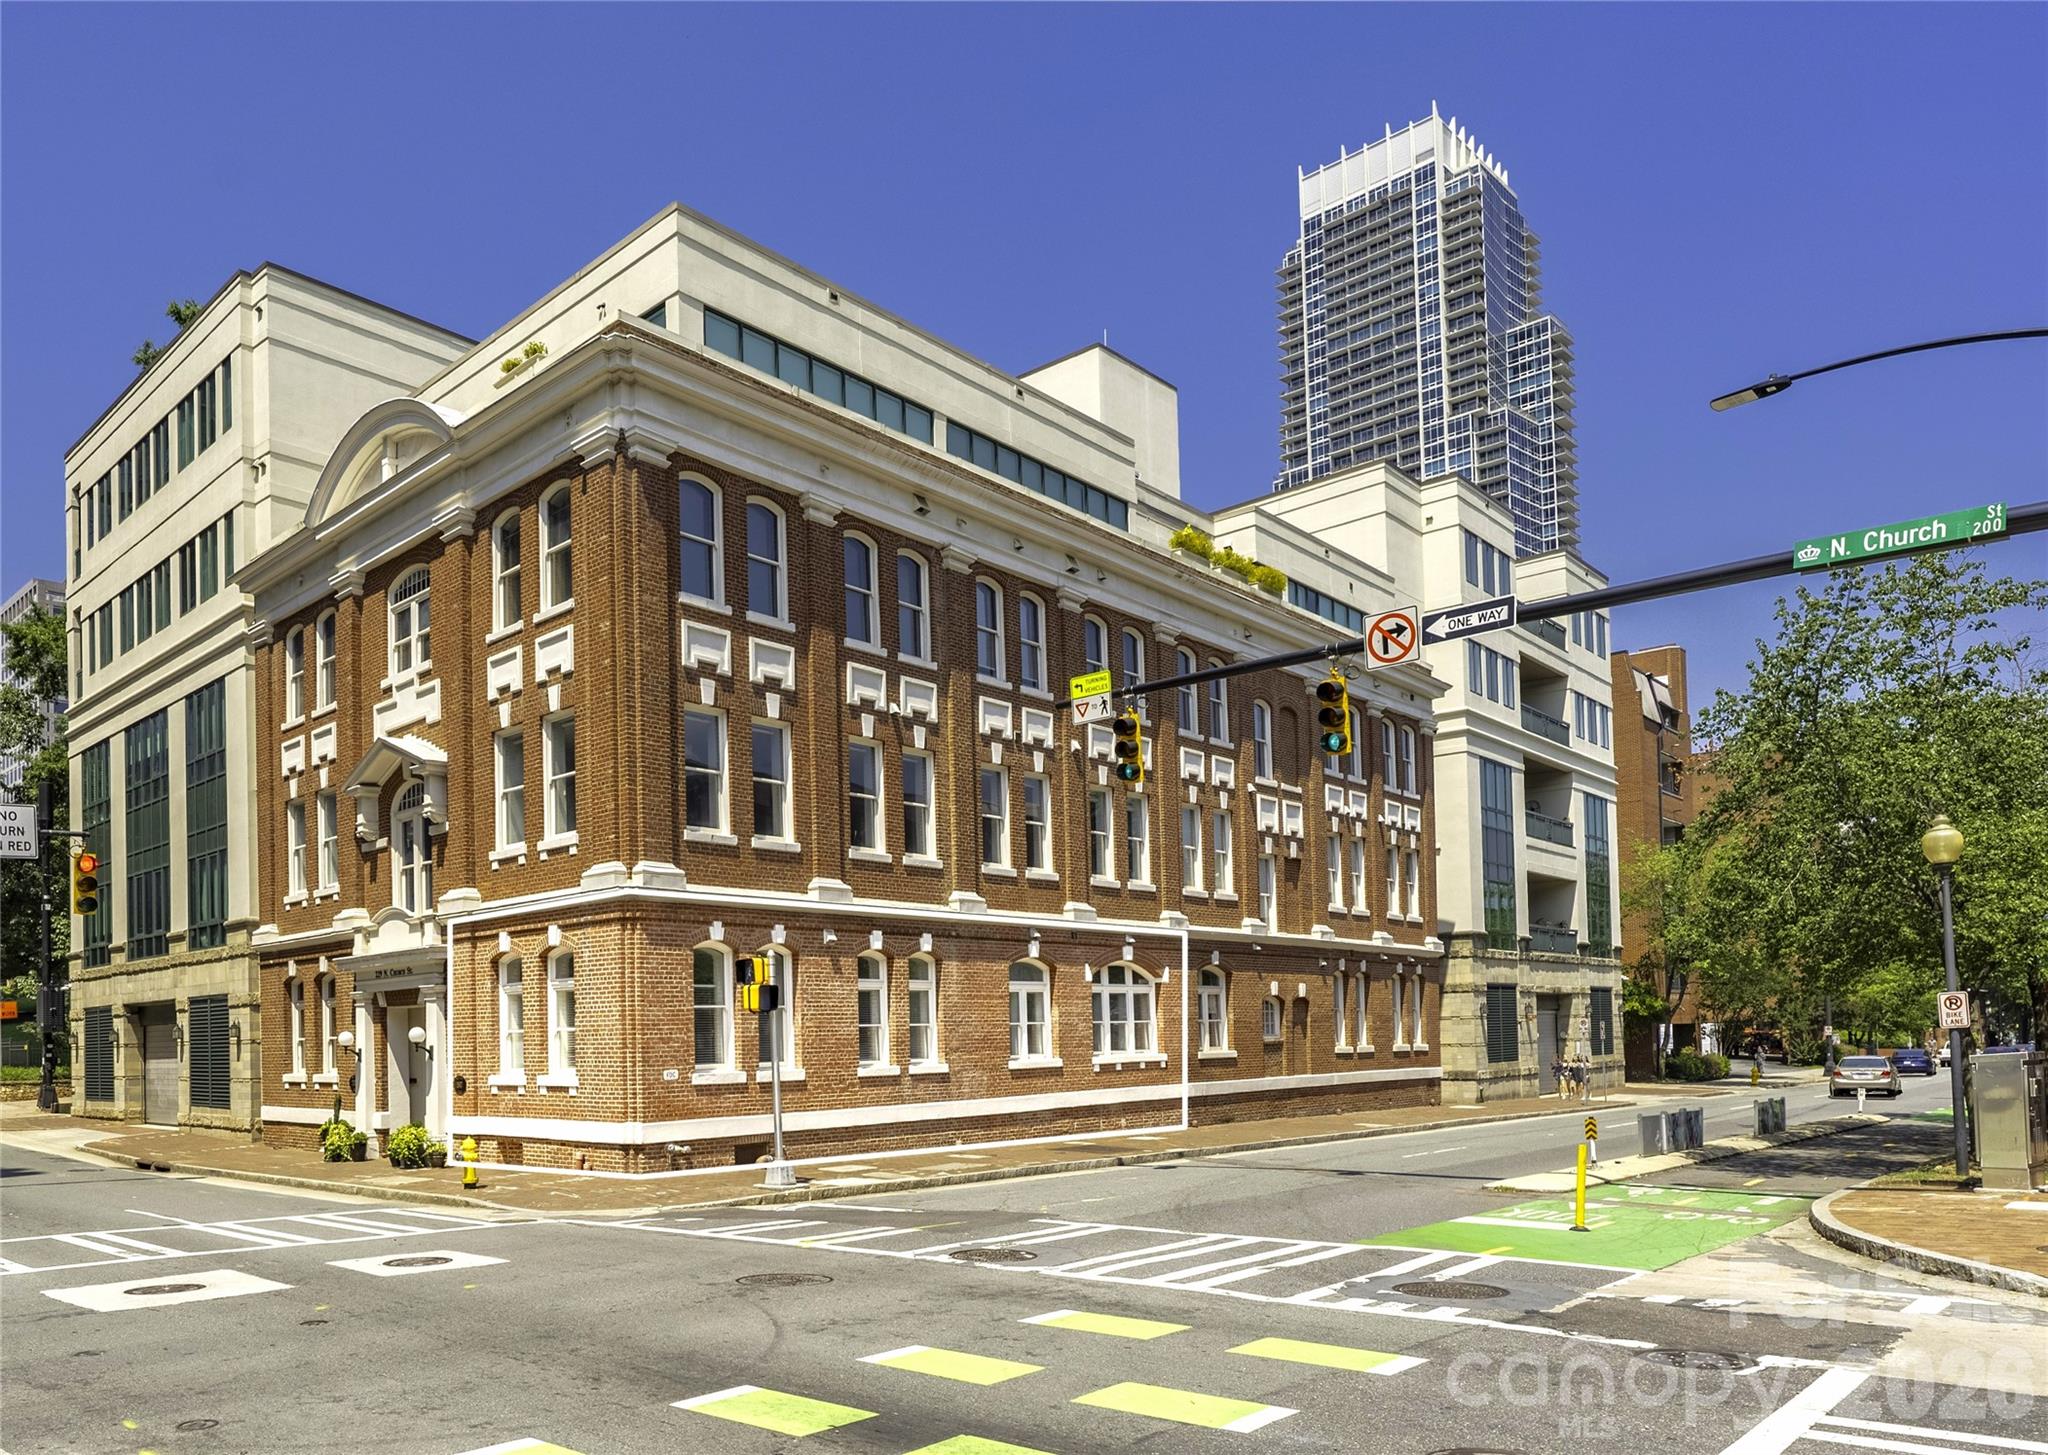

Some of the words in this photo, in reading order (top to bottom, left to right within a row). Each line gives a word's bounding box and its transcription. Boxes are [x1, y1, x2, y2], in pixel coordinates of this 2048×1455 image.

[1831, 537, 1850, 558] N.
[1863, 520, 1946, 551] Church
[1987, 504, 2002, 518] St
[1973, 518, 2001, 536] 200
[1448, 615, 1473, 630] ONE
[1478, 608, 1504, 623] WAY
[1085, 675, 1107, 684] TURNING
[1084, 684, 1108, 693] VEHICLES
[0, 811, 17, 821] NO
[0, 826, 24, 836] URN
[8, 841, 31, 851] RED
